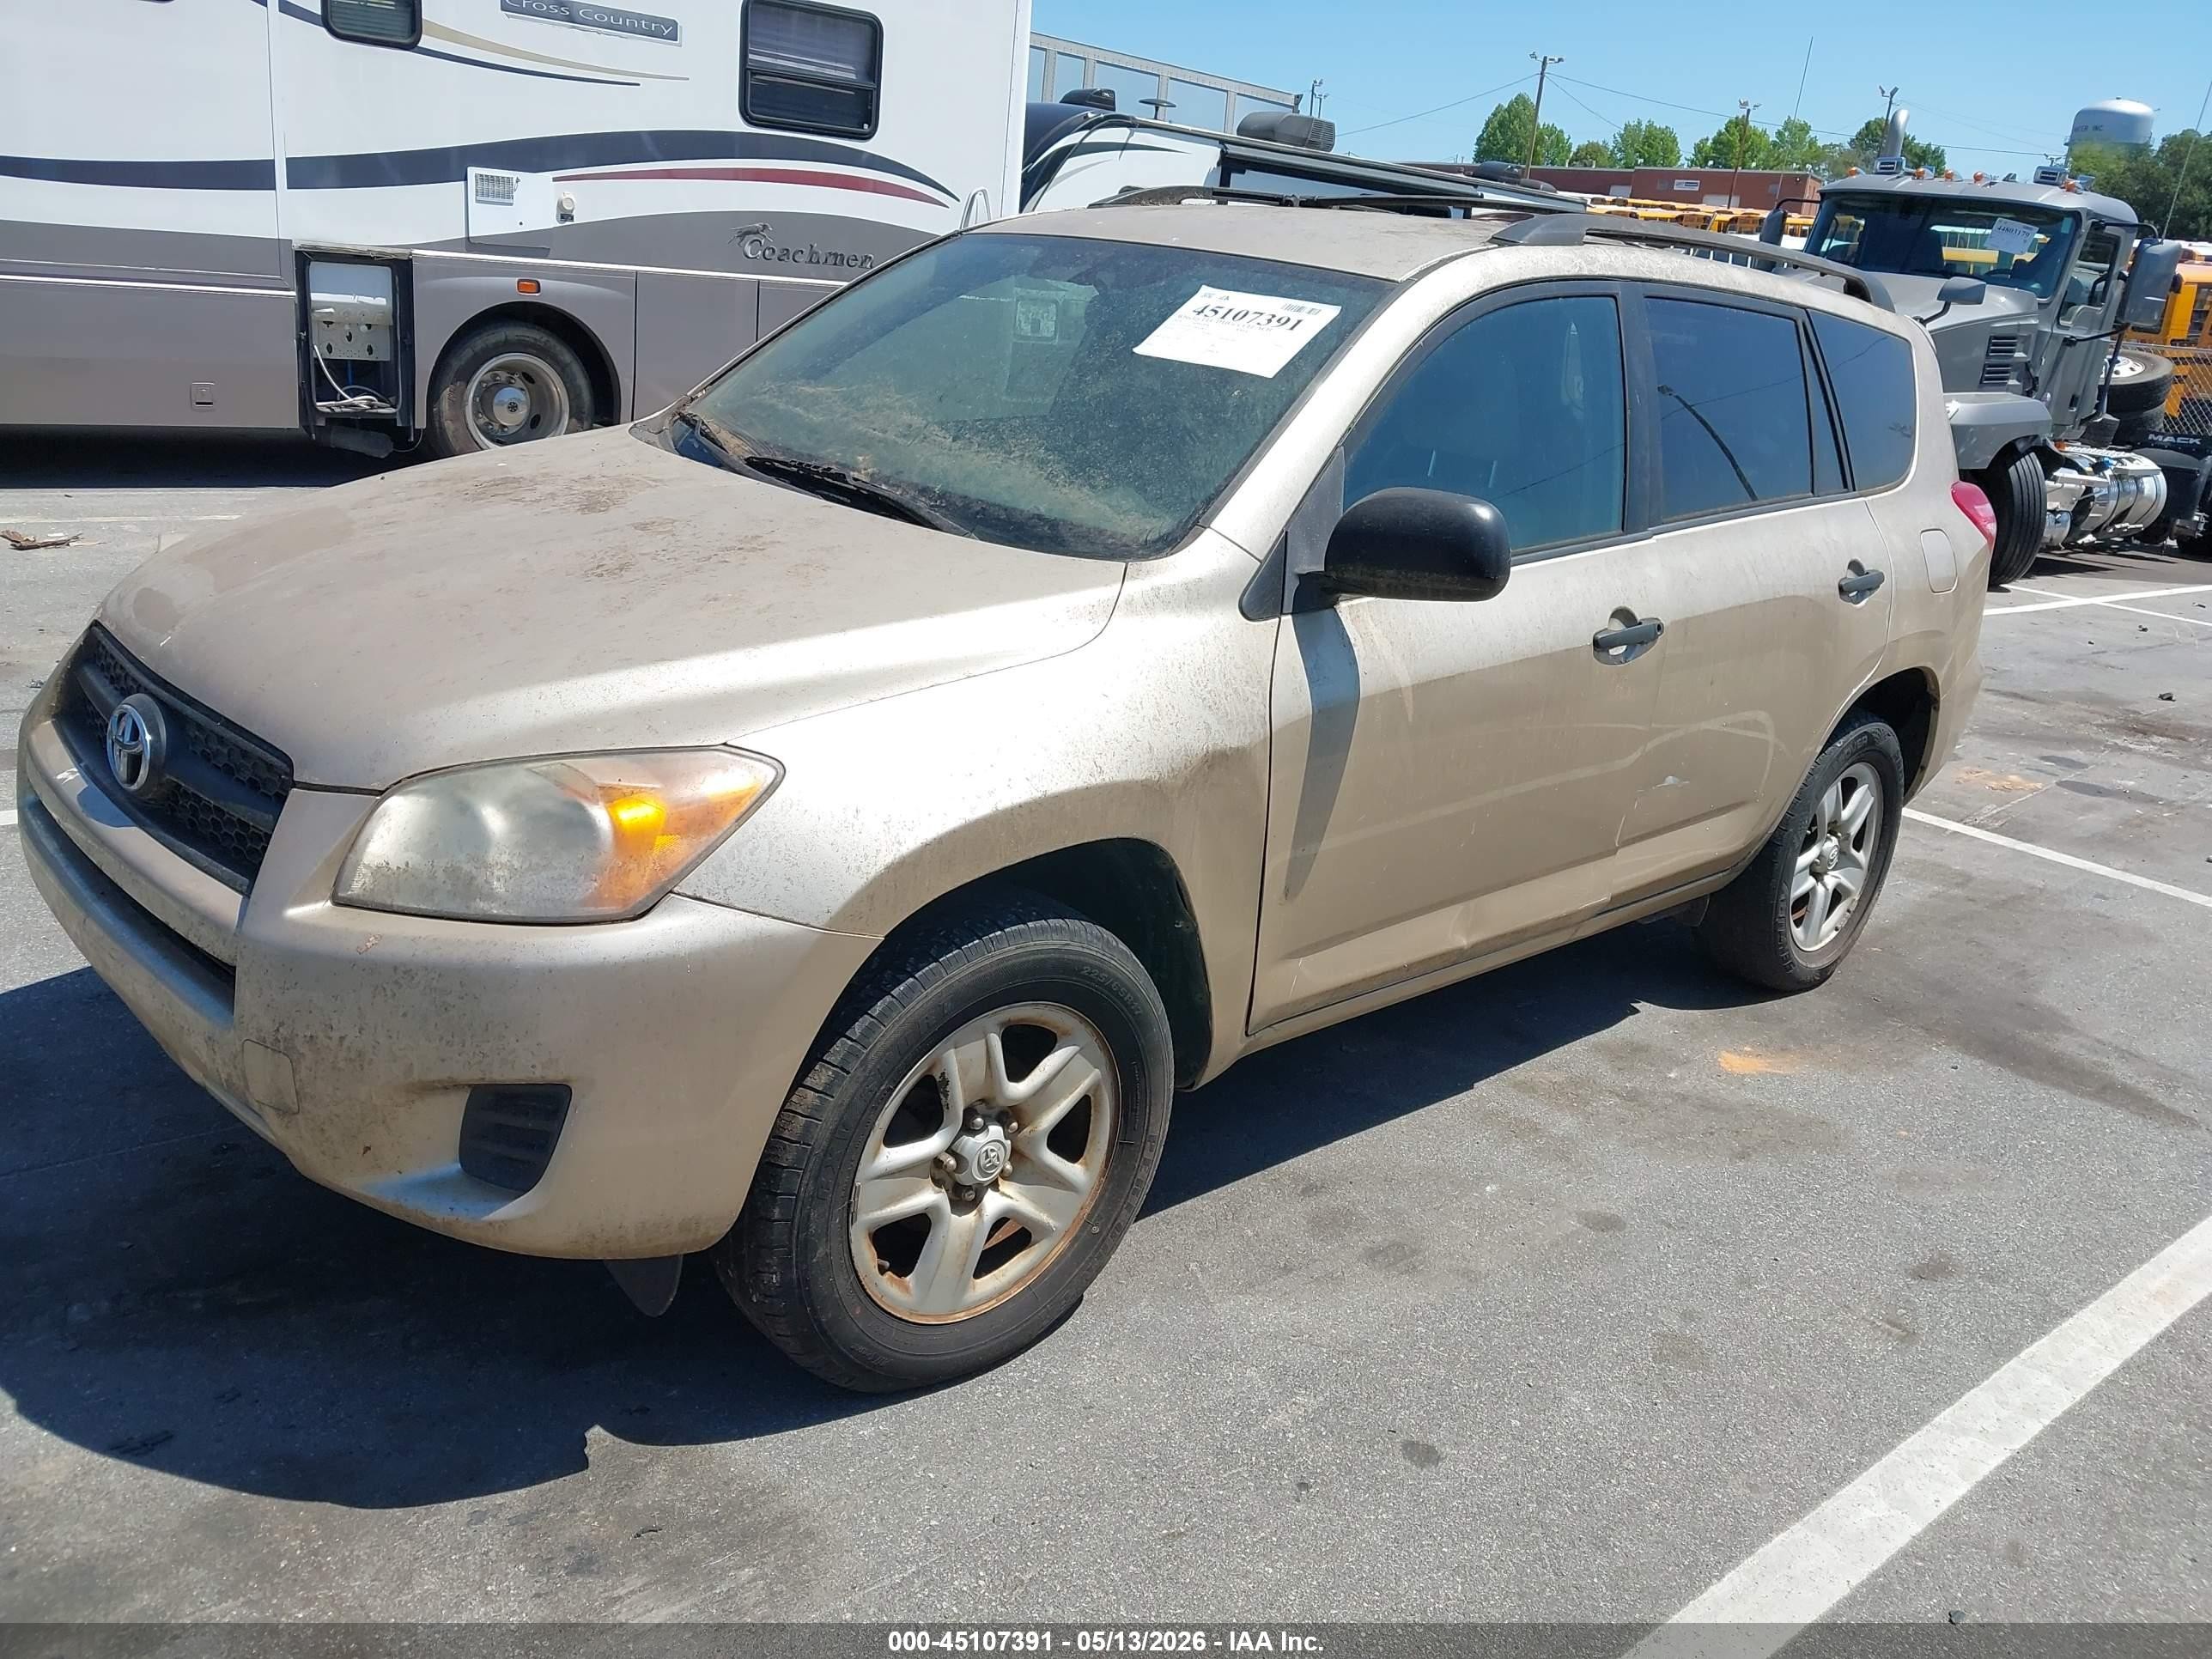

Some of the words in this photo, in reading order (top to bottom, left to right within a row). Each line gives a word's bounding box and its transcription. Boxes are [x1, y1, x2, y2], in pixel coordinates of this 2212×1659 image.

[505, 0, 570, 15] Cross
[579, 9, 673, 36] Country
[744, 238, 874, 270] Coachmen
[1192, 303, 1304, 331] 45107391
[2148, 433, 2203, 445] MACK
